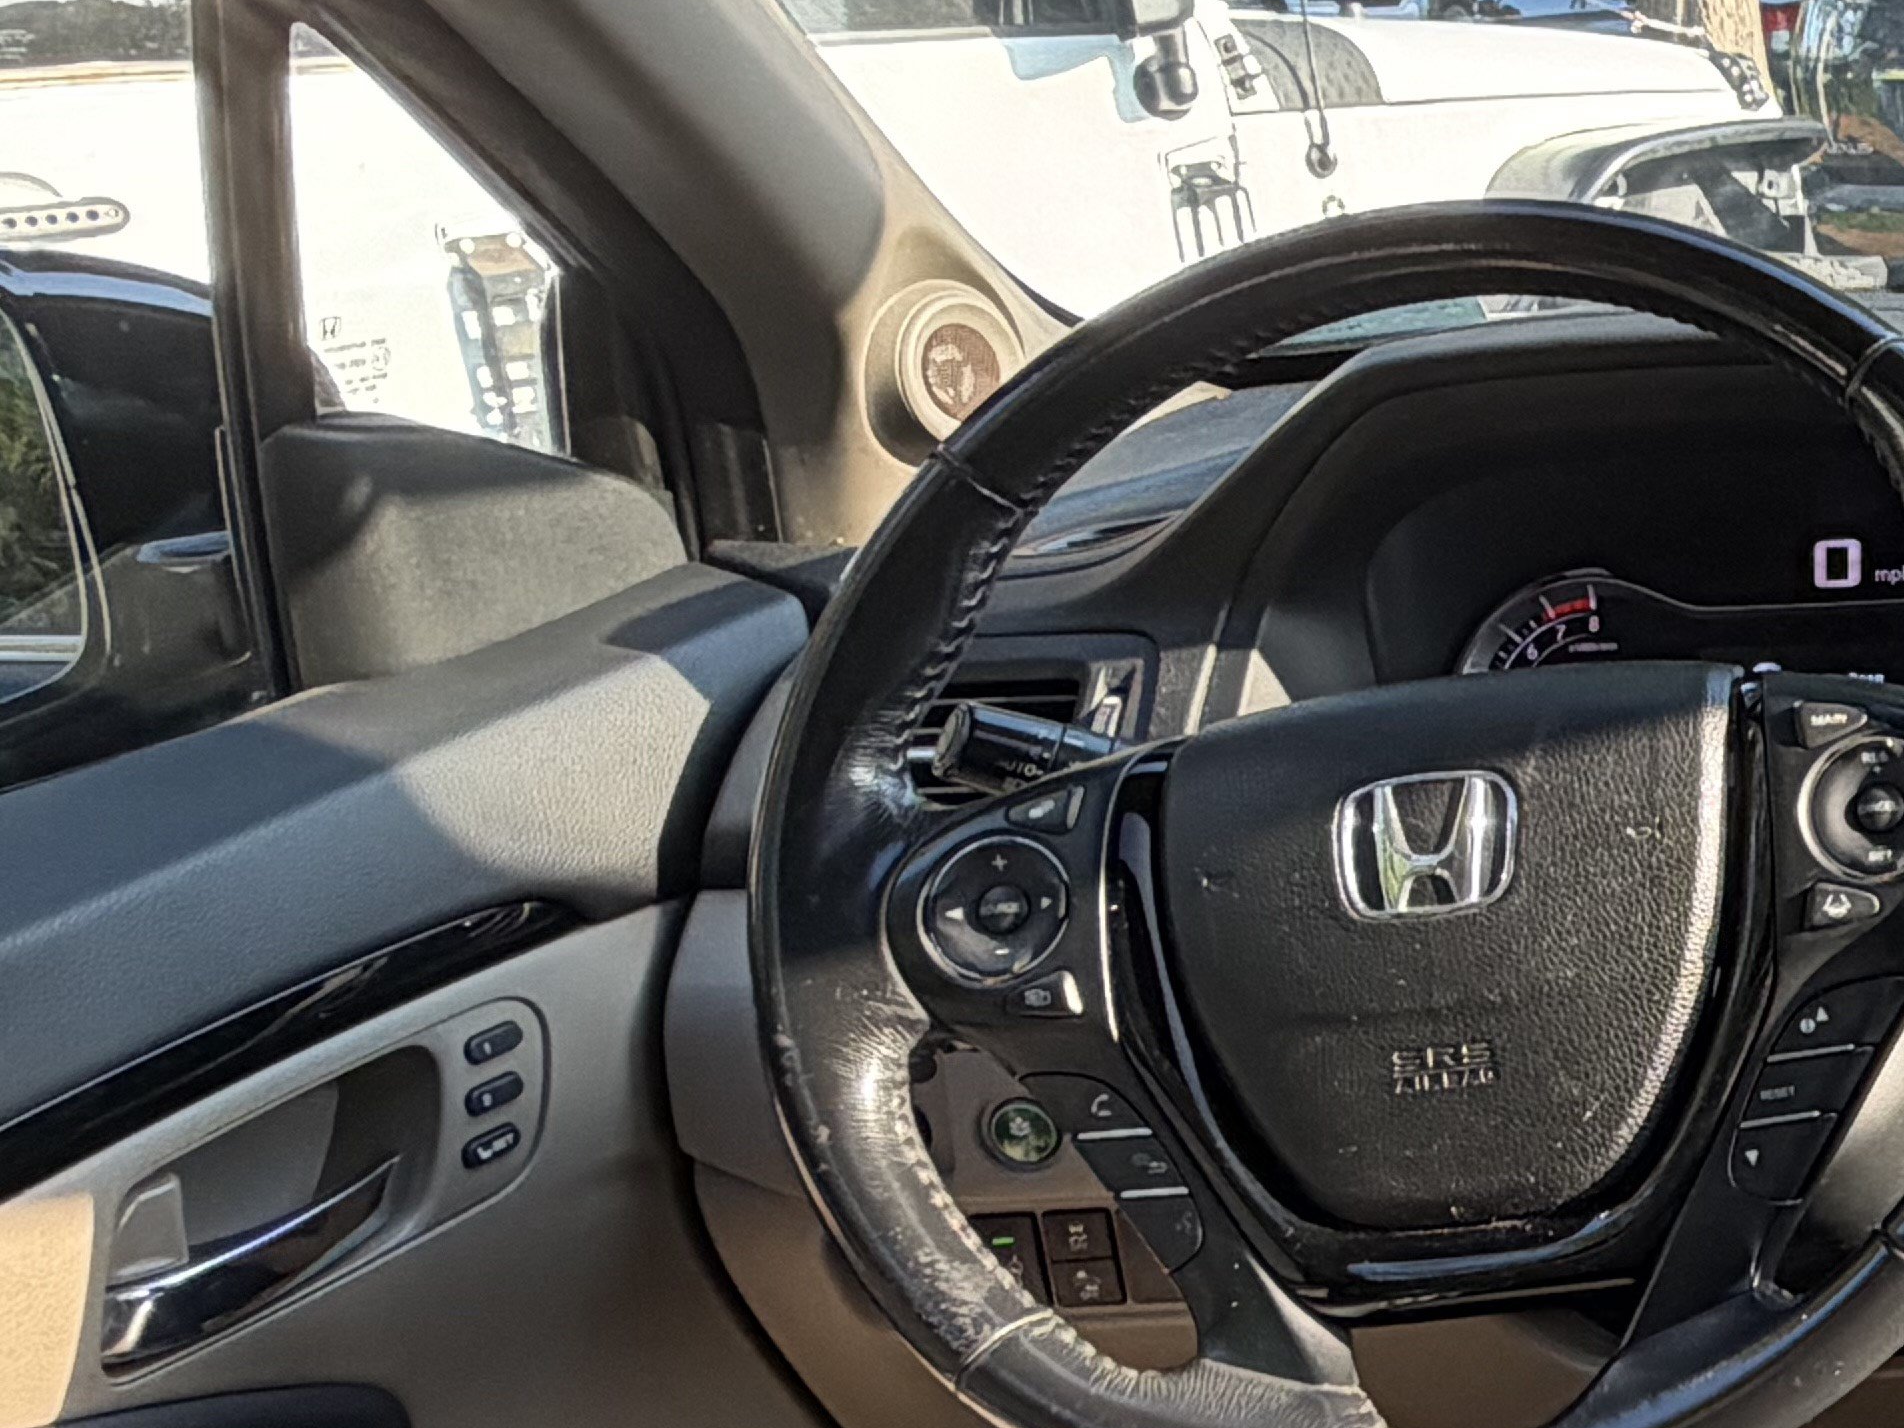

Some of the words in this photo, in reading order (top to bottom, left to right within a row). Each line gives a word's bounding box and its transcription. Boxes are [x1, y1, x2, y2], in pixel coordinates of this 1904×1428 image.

[1813, 538, 1862, 589] 0
[1554, 624, 1566, 642] 7
[1526, 644, 1538, 660] 6
